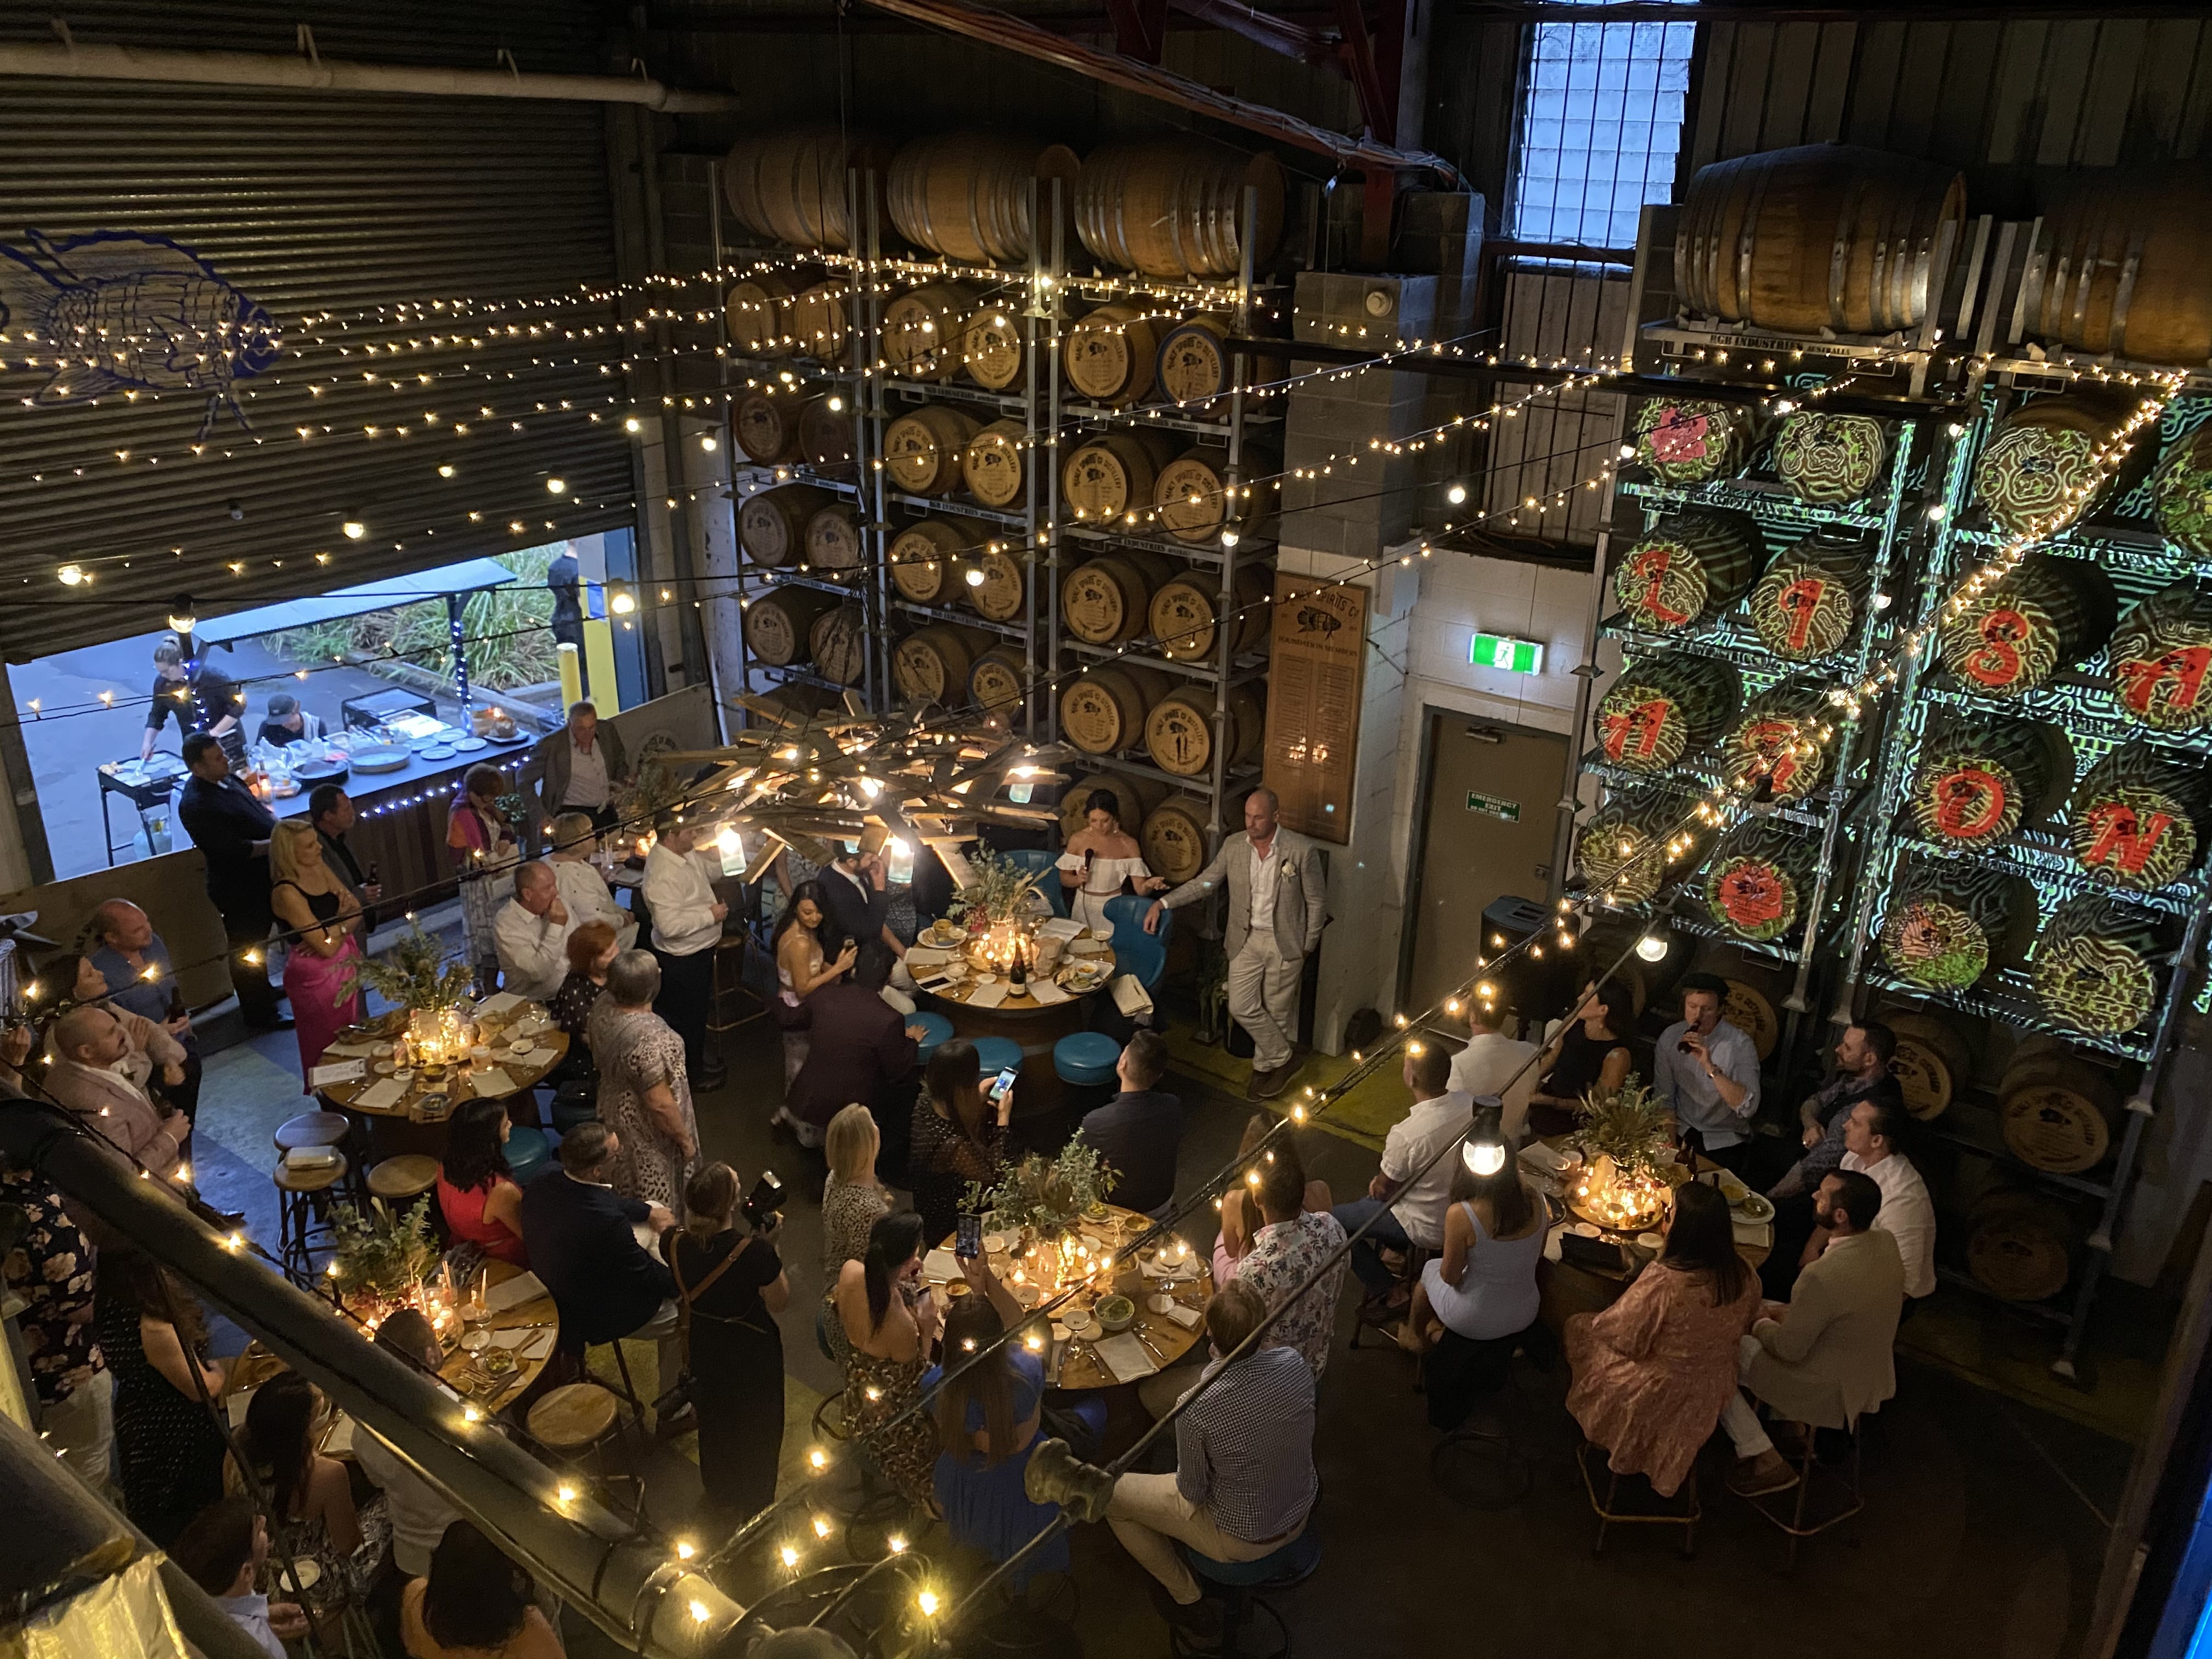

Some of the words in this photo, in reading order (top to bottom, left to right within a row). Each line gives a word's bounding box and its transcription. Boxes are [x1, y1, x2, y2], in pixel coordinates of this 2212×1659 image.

[1278, 635, 1324, 650] FOUNDATION
[1324, 644, 1358, 657] MEMBERS
[1471, 793, 1516, 809] EMERGENCY
[1485, 803, 1502, 811] EXIT
